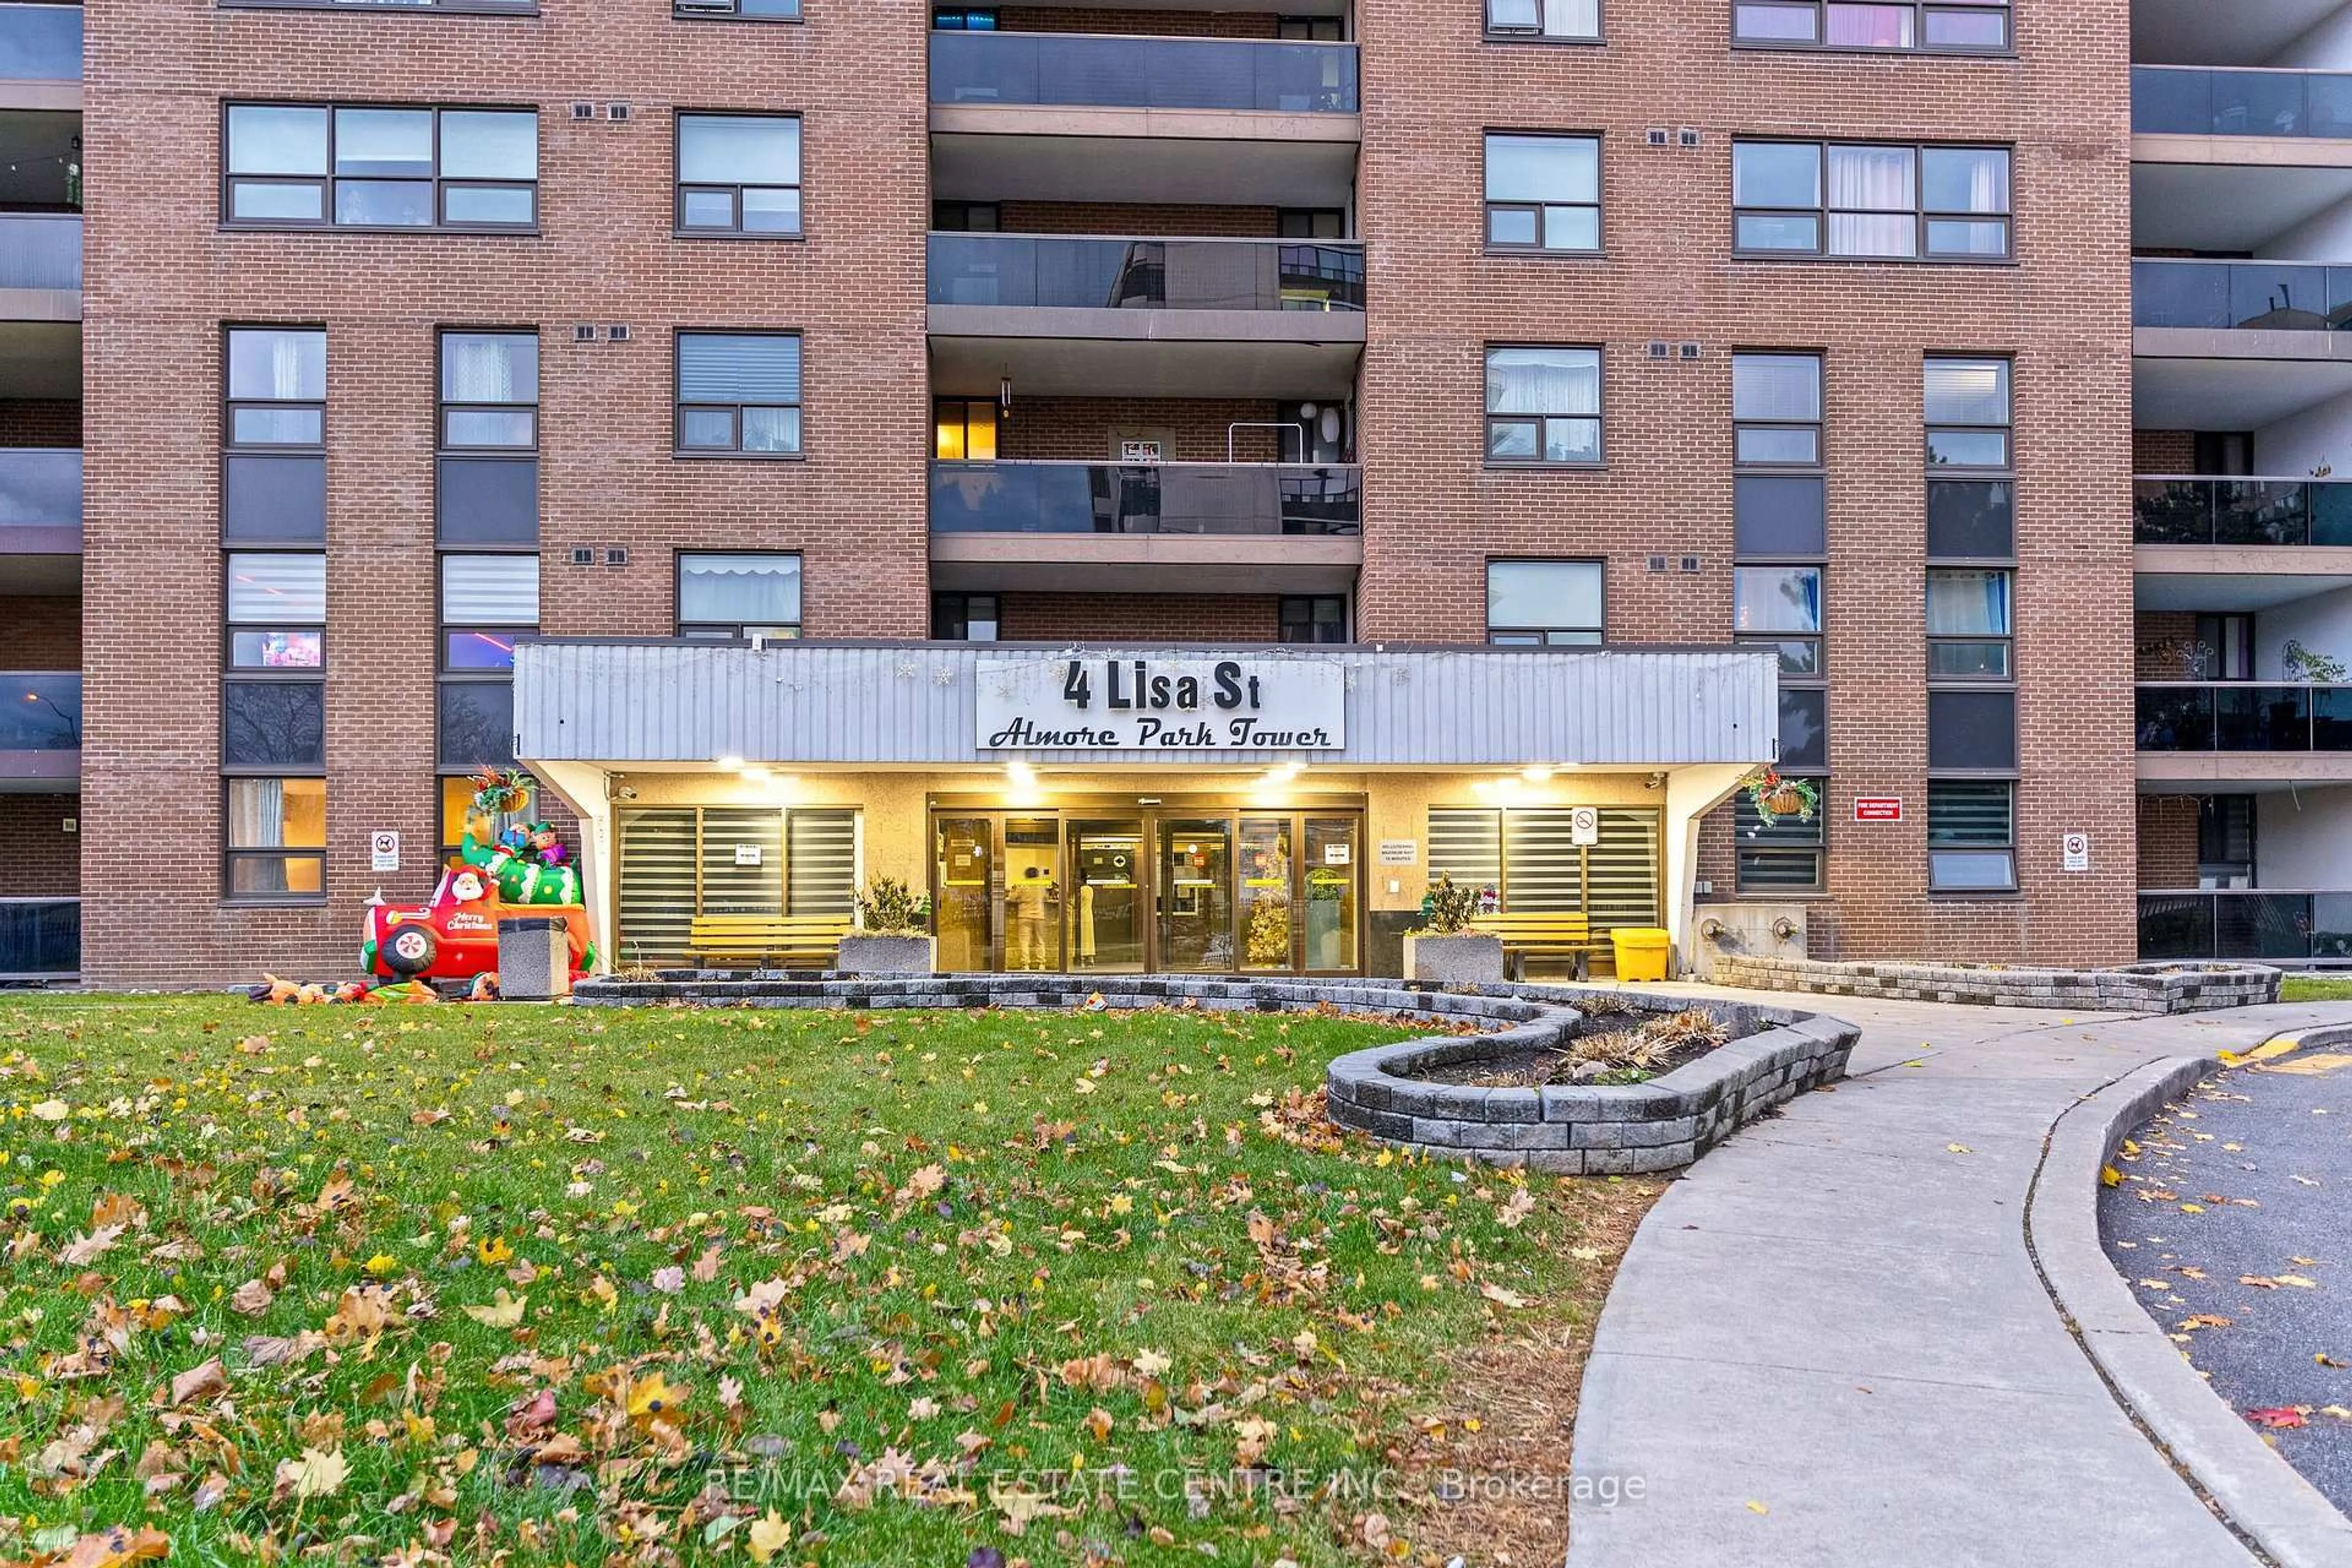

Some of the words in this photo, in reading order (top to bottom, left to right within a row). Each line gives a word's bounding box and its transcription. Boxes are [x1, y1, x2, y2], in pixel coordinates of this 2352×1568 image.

[1063, 660, 1091, 710] 4
[1107, 660, 1199, 710] Lisa
[1214, 661, 1261, 709] St
[989, 716, 1120, 747] Almore
[1137, 717, 1217, 747] Park
[1229, 717, 1332, 747] Tower
[447, 919, 493, 930] Christmas
[453, 911, 484, 924] Merry
